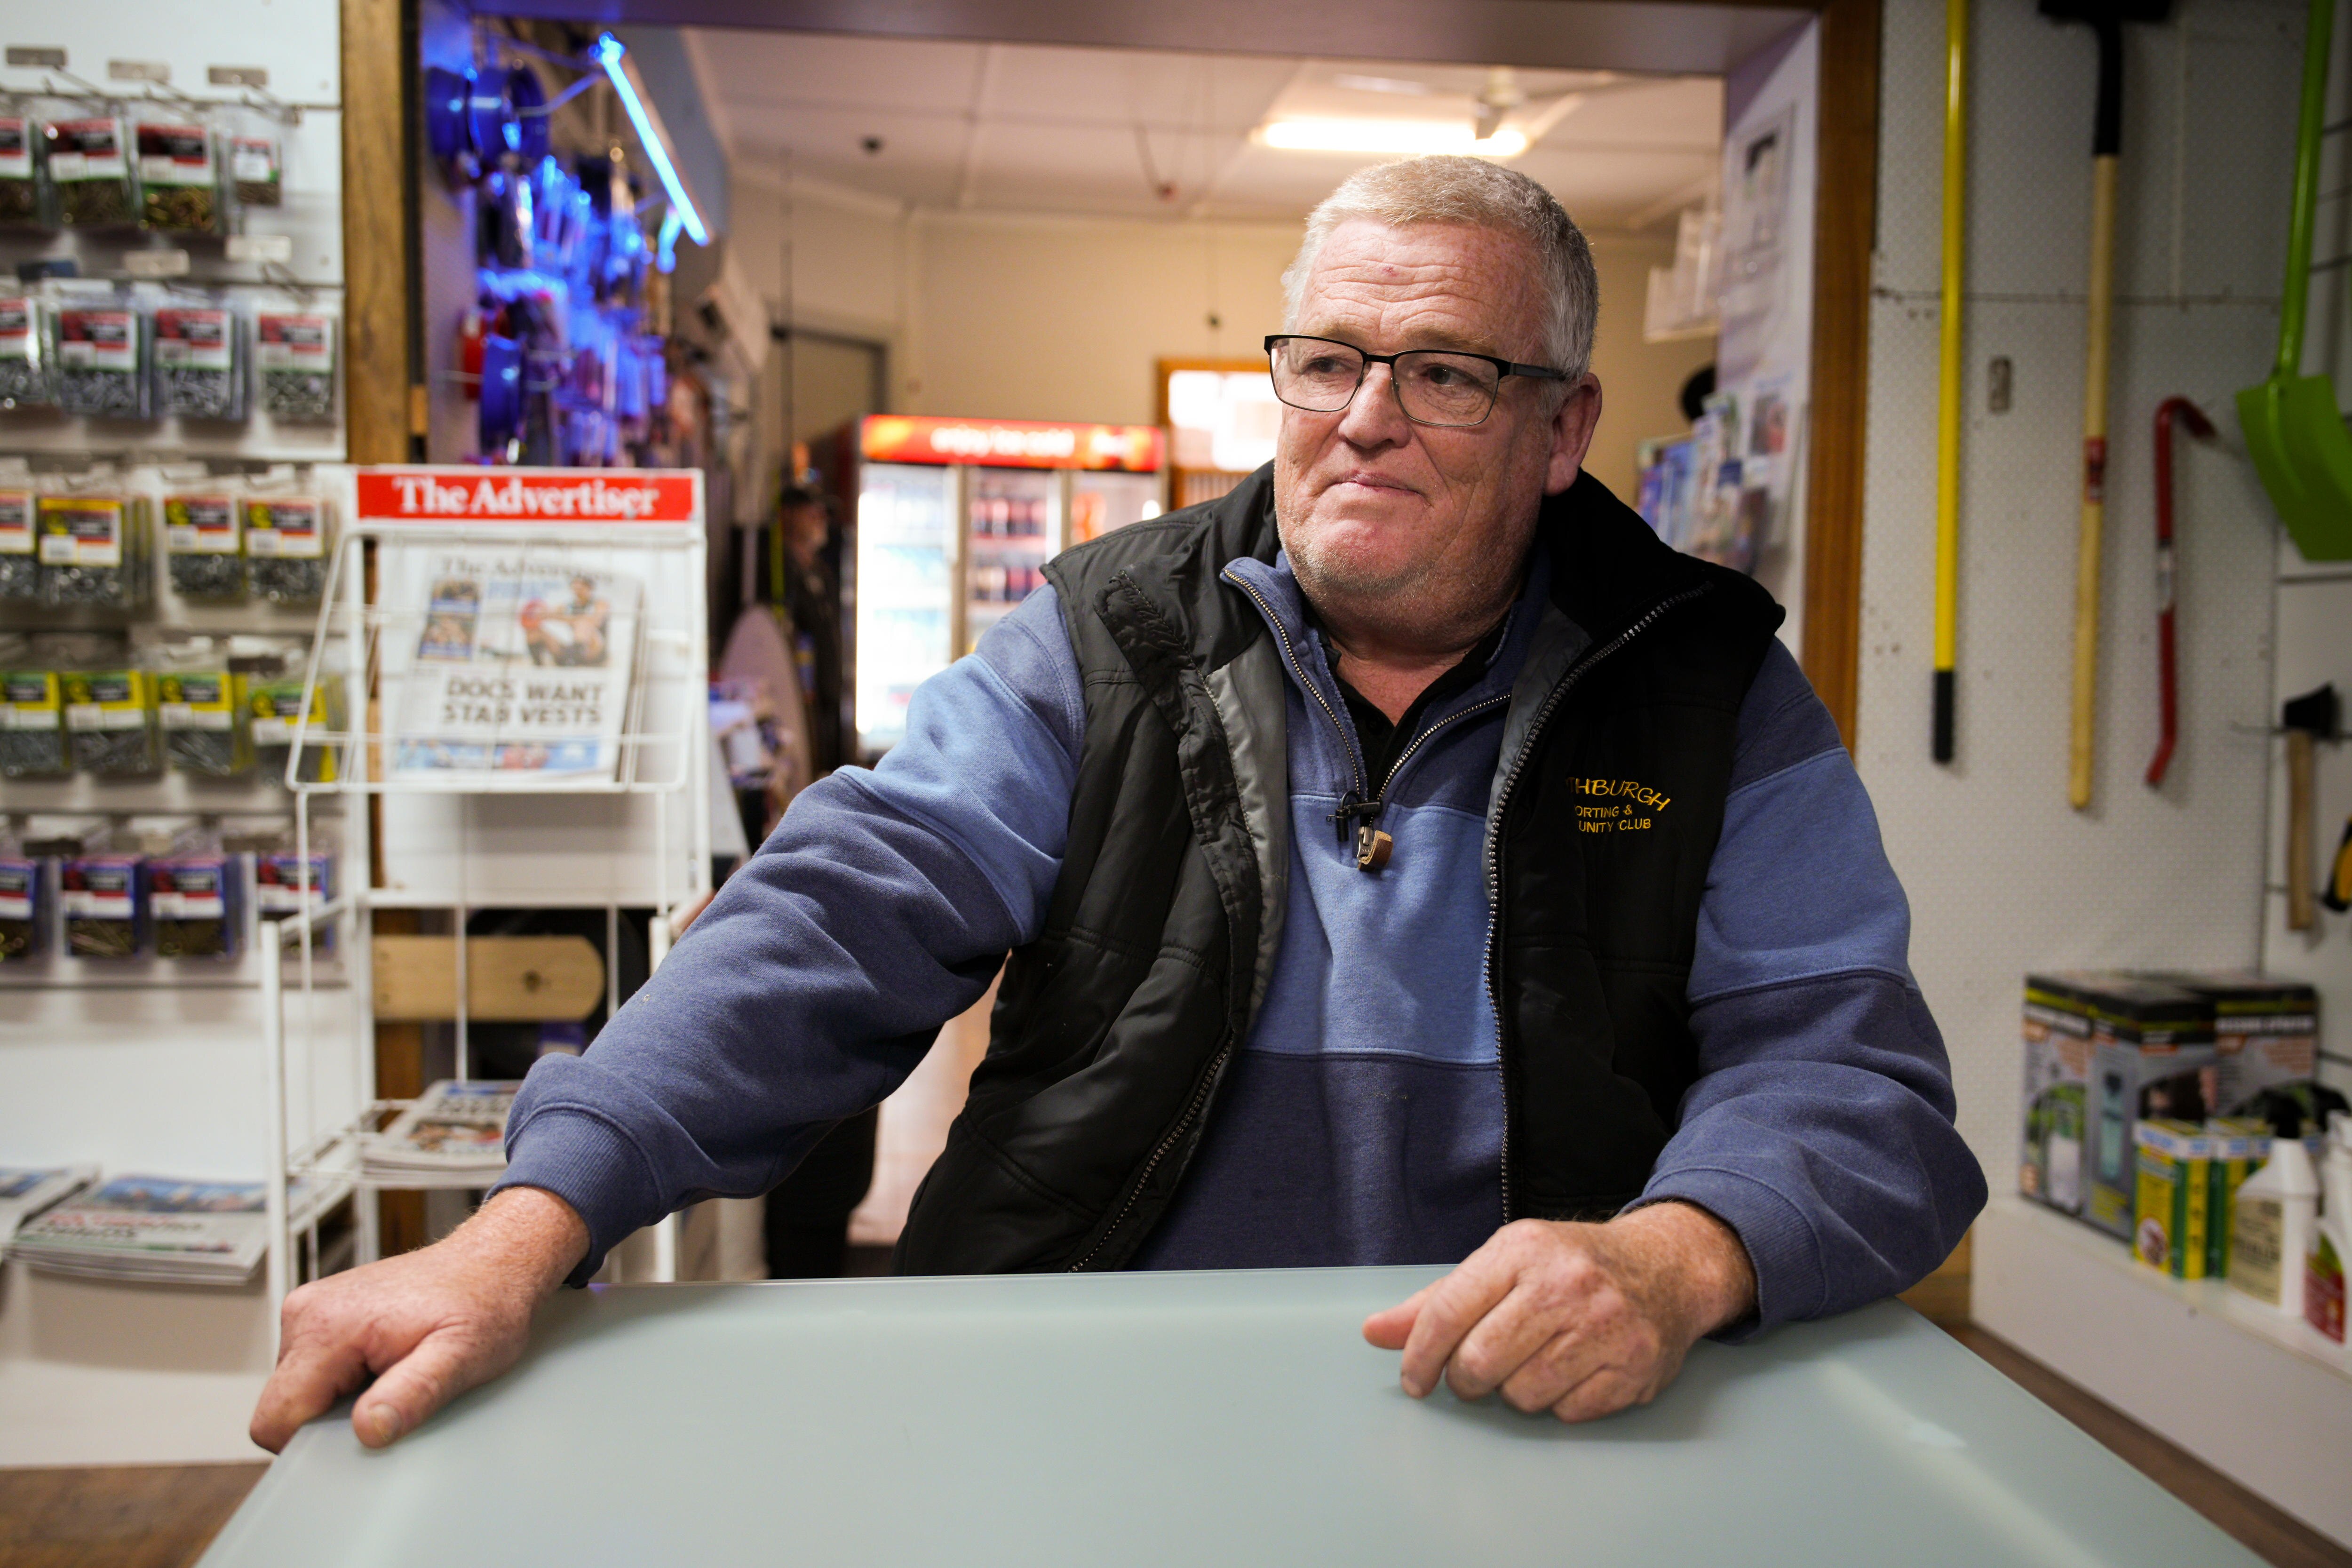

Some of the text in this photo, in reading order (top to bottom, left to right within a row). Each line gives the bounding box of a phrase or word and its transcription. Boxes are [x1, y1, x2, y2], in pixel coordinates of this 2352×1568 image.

[391, 475, 660, 516] The Advertiser
[526, 682, 605, 701] WANT
[441, 704, 603, 724] STAB VESTS
[1623, 804, 1633, 815] &
[1579, 818, 1652, 833] UNITY CLUB
